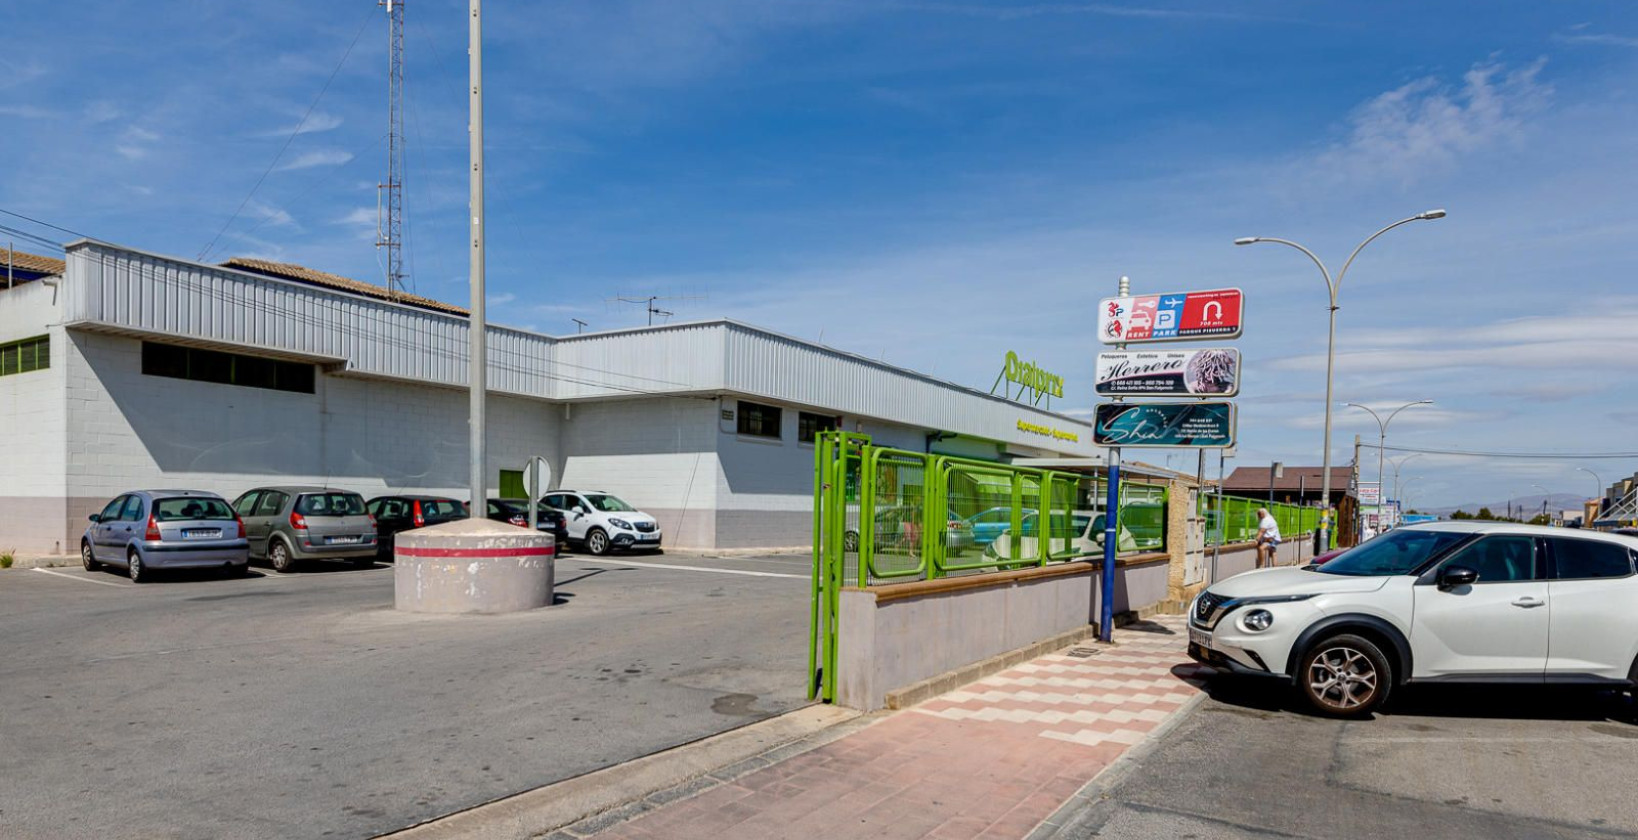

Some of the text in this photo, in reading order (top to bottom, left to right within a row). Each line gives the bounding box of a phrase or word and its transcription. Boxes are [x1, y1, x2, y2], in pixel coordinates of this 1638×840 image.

[1127, 331, 1150, 339] RENT
[1153, 329, 1176, 337] PARK
[1100, 359, 1184, 381] Herrero
